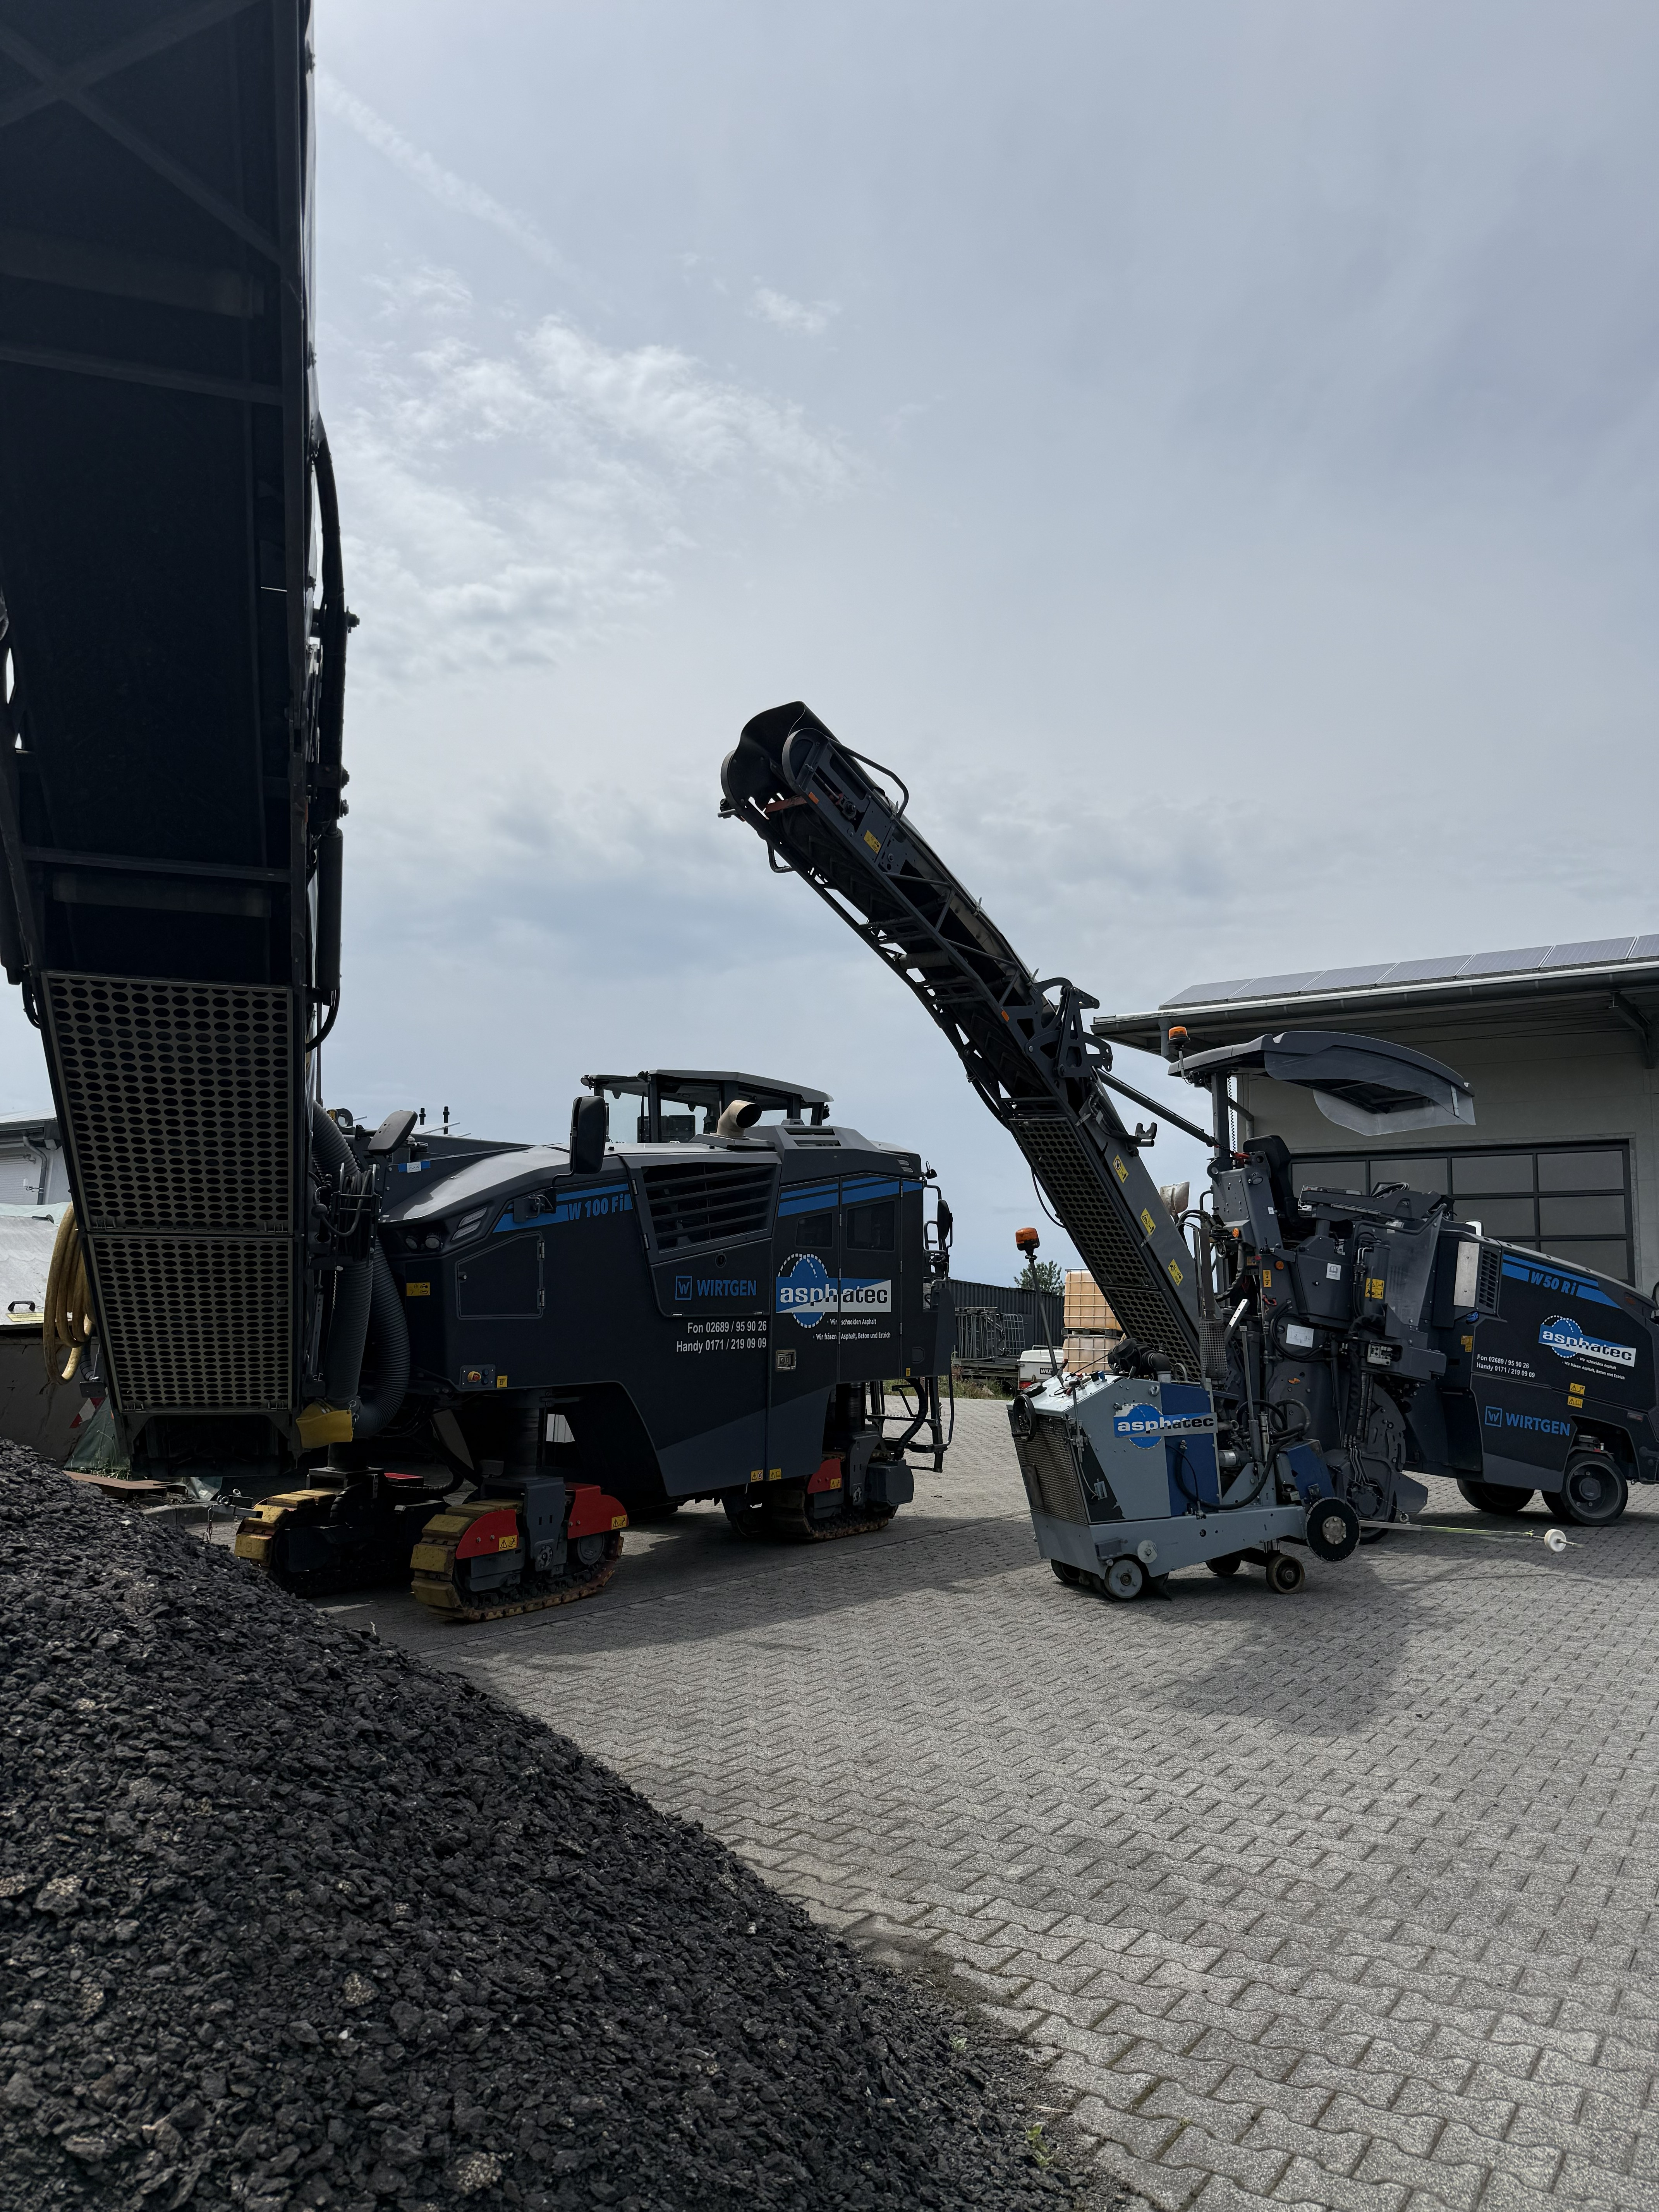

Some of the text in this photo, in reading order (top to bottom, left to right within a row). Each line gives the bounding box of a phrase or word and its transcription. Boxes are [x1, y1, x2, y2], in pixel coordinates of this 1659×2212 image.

[568, 1194, 623, 1220] W 100 Fi
[697, 1280, 757, 1296] WIRTGEN
[780, 1284, 888, 1307] asphatec
[1561, 1281, 1577, 1295] Ri
[687, 1321, 767, 1333] Fon 02689 / 95 90 26
[677, 1337, 766, 1354] Handy 0171 / 219 09 09
[1542, 1331, 1632, 1361] asphatec
[1476, 1362, 1493, 1372] Handy
[1489, 1356, 1504, 1364] 02689
[1118, 1417, 1214, 1434] asphatec
[1506, 1412, 1570, 1436] WIRTGEN
